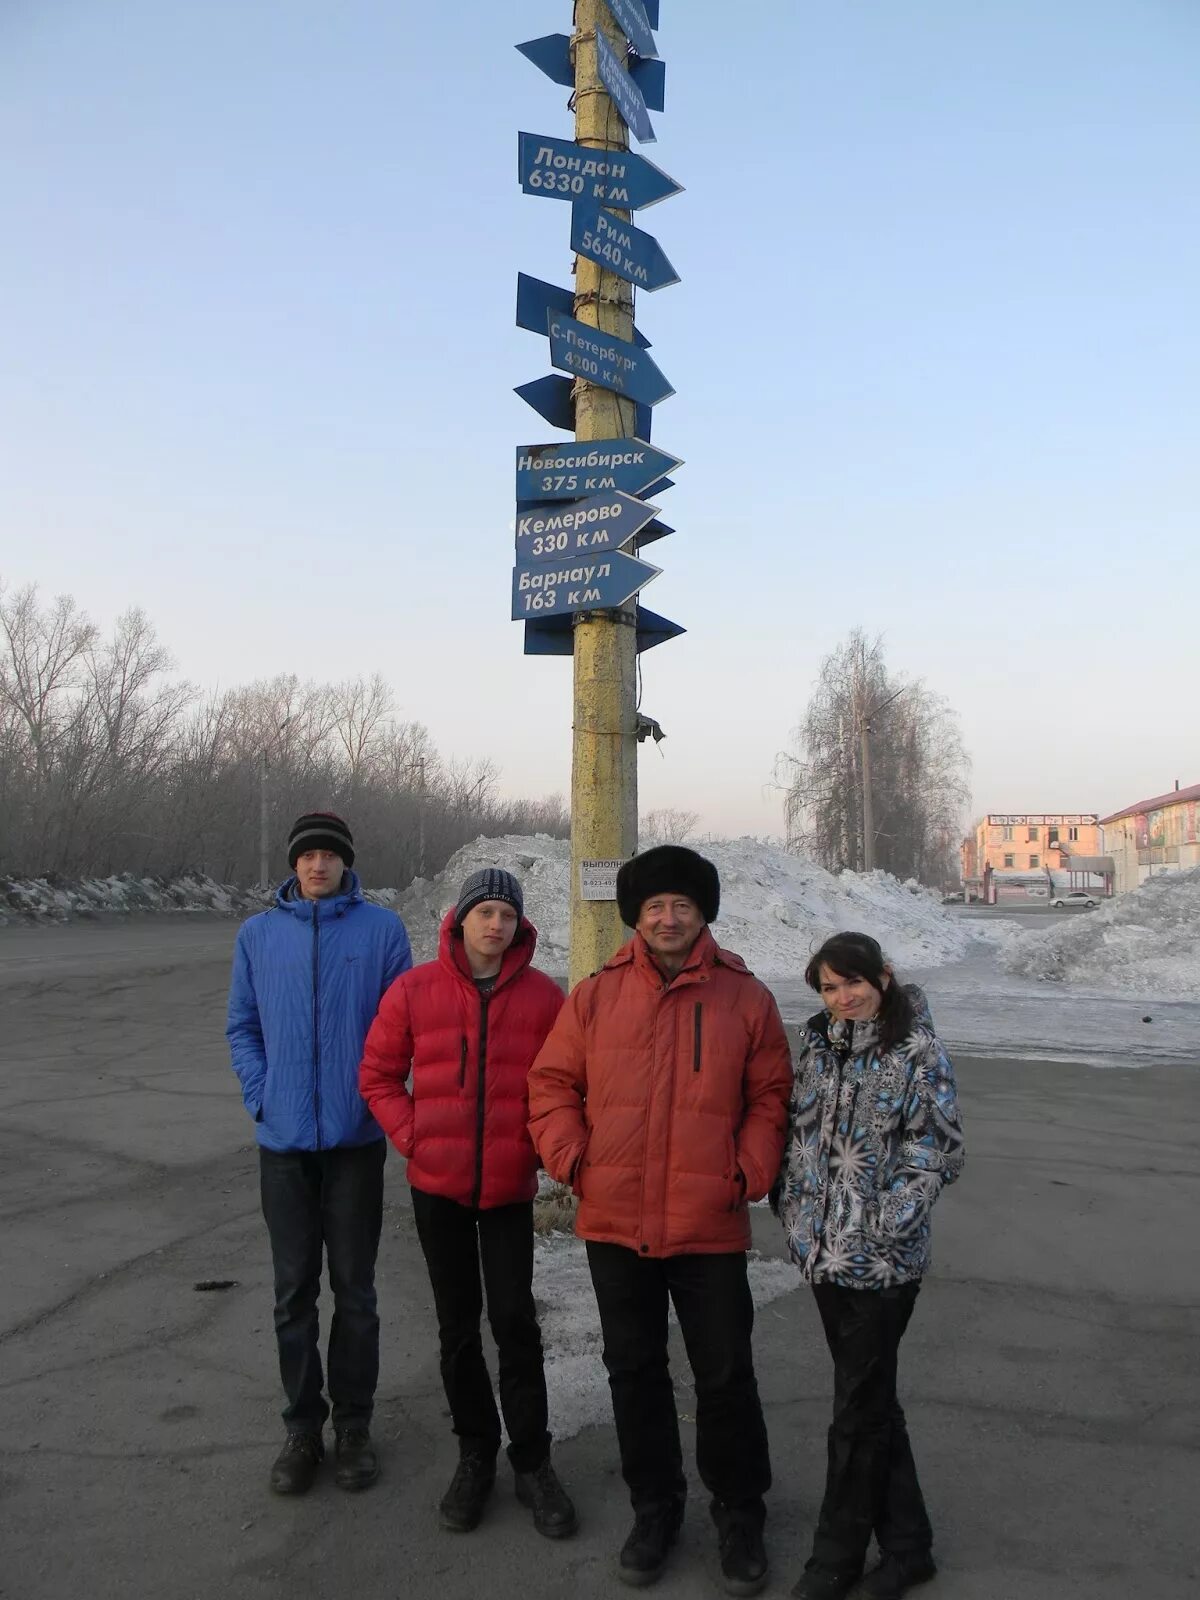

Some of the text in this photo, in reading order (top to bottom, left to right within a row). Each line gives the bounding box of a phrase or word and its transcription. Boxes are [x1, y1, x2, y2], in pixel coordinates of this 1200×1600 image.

[624, 101, 637, 129] км
[534, 147, 625, 178] Лондон
[529, 169, 629, 201] 6330 км
[596, 215, 632, 250] Рим
[581, 230, 648, 281] 5640 км
[550, 323, 637, 371] С-Петербург
[603, 369, 623, 387] км
[518, 451, 645, 471] Новосибирск
[541, 475, 616, 491] 375 км
[518, 503, 622, 537] Кемерово
[532, 529, 609, 555] 330 км
[518, 563, 610, 591] Барнаул
[525, 588, 601, 611] 163 км
[483, 893, 511, 901] adida
